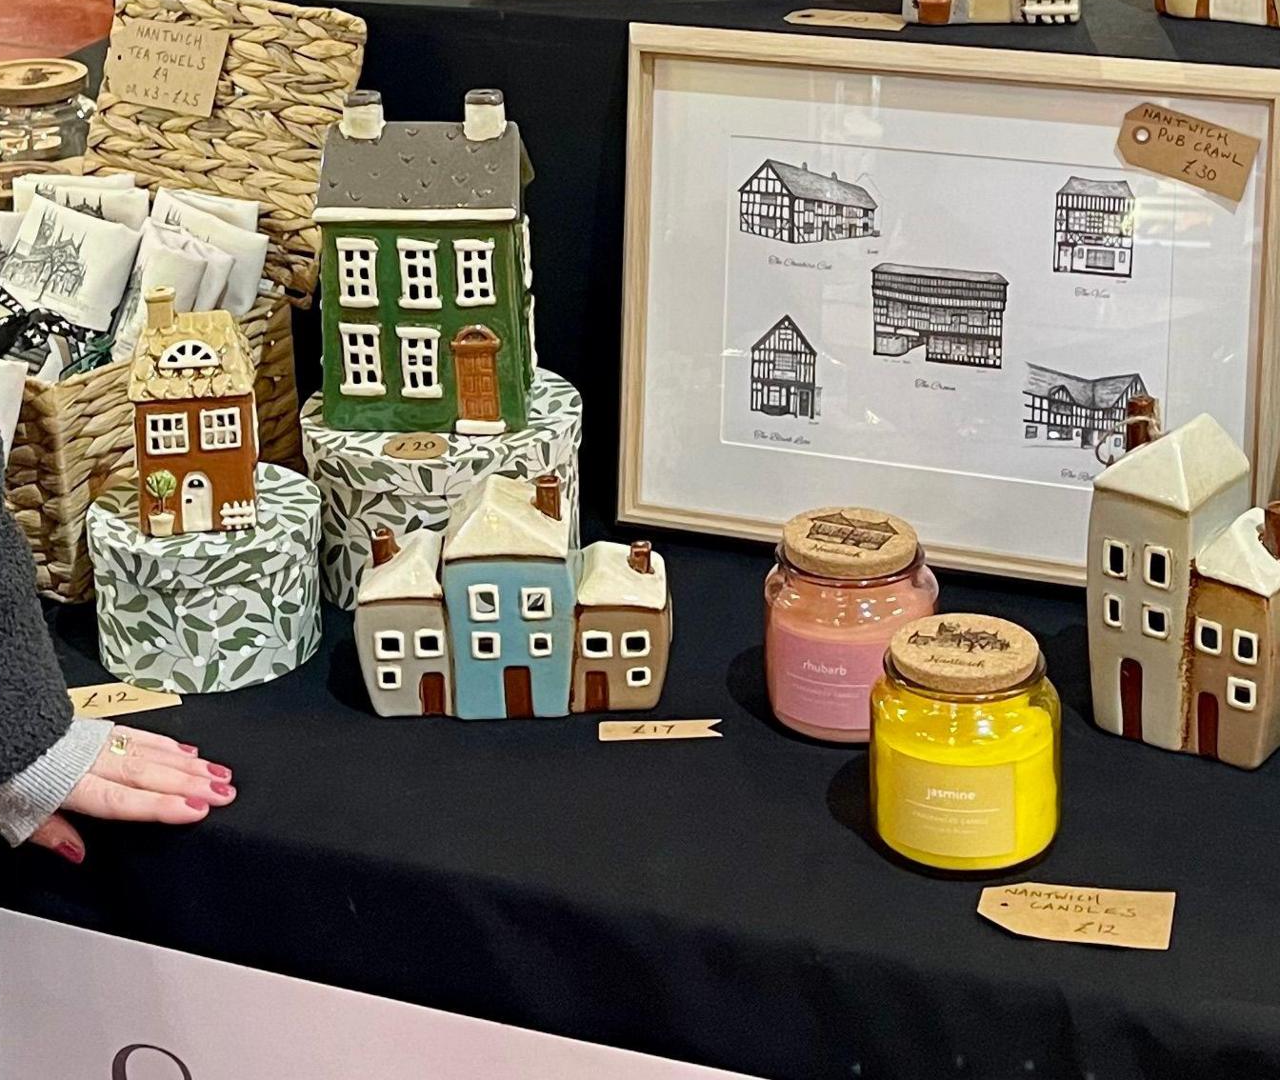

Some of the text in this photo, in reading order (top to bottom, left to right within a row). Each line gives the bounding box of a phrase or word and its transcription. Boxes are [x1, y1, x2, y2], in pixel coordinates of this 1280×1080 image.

[136, 26, 203, 49] NANTWICH
[128, 45, 207, 71] TEA TOWELS
[1143, 108, 1229, 146] NANTWICH
[1158, 127, 1245, 168] PUB CRAWL
[1181, 159, 1218, 181] £30
[395, 439, 437, 453] £20
[802, 658, 848, 677] rhubarb
[81, 690, 139, 708] £12
[926, 786, 977, 801] jasmine
[1004, 887, 1105, 906] NANTWICH
[1030, 901, 1137, 918] CANDLES
[1074, 921, 1121, 936] £12
